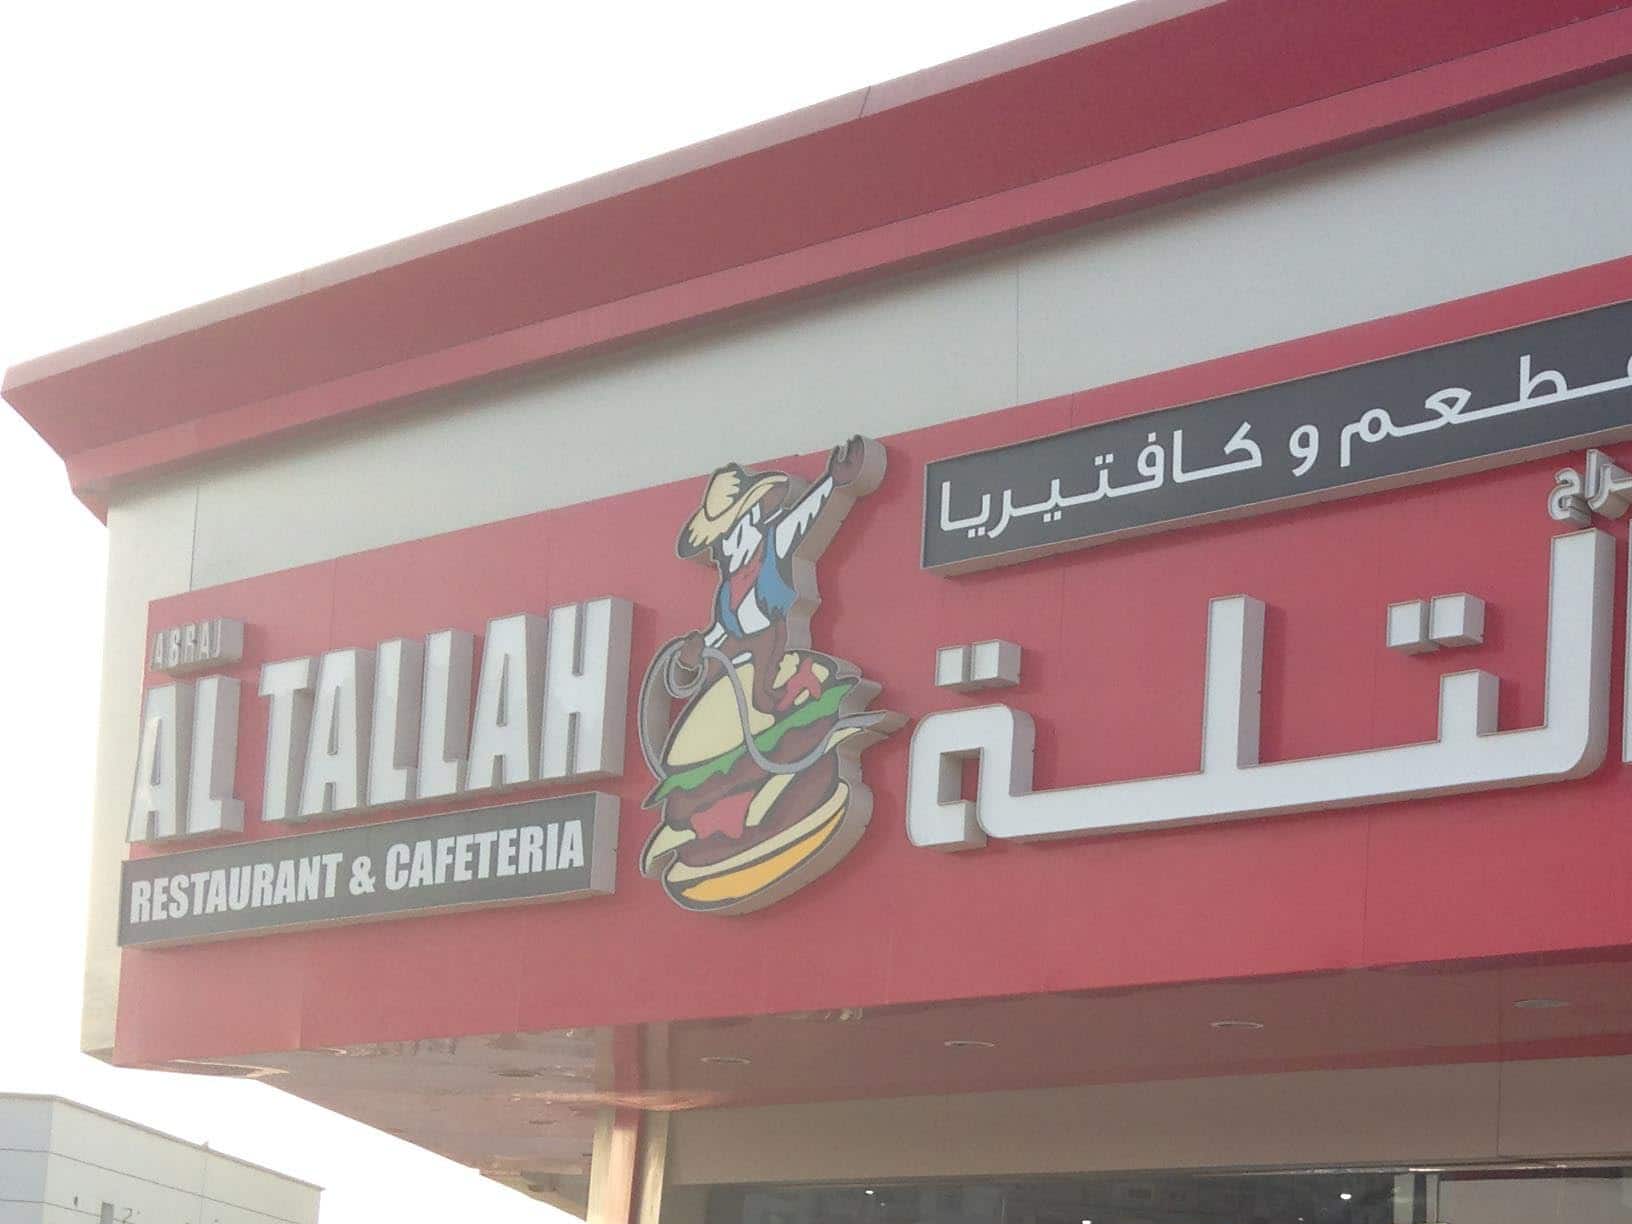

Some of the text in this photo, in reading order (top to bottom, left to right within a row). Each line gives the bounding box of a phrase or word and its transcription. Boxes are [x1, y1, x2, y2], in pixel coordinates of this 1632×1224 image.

[938, 421, 1262, 541] كافتيريا
[1289, 423, 1320, 477] و
[128, 595, 636, 845] AL TALLAH
[129, 820, 585, 924] RESTAURANT & CAFETERIA
